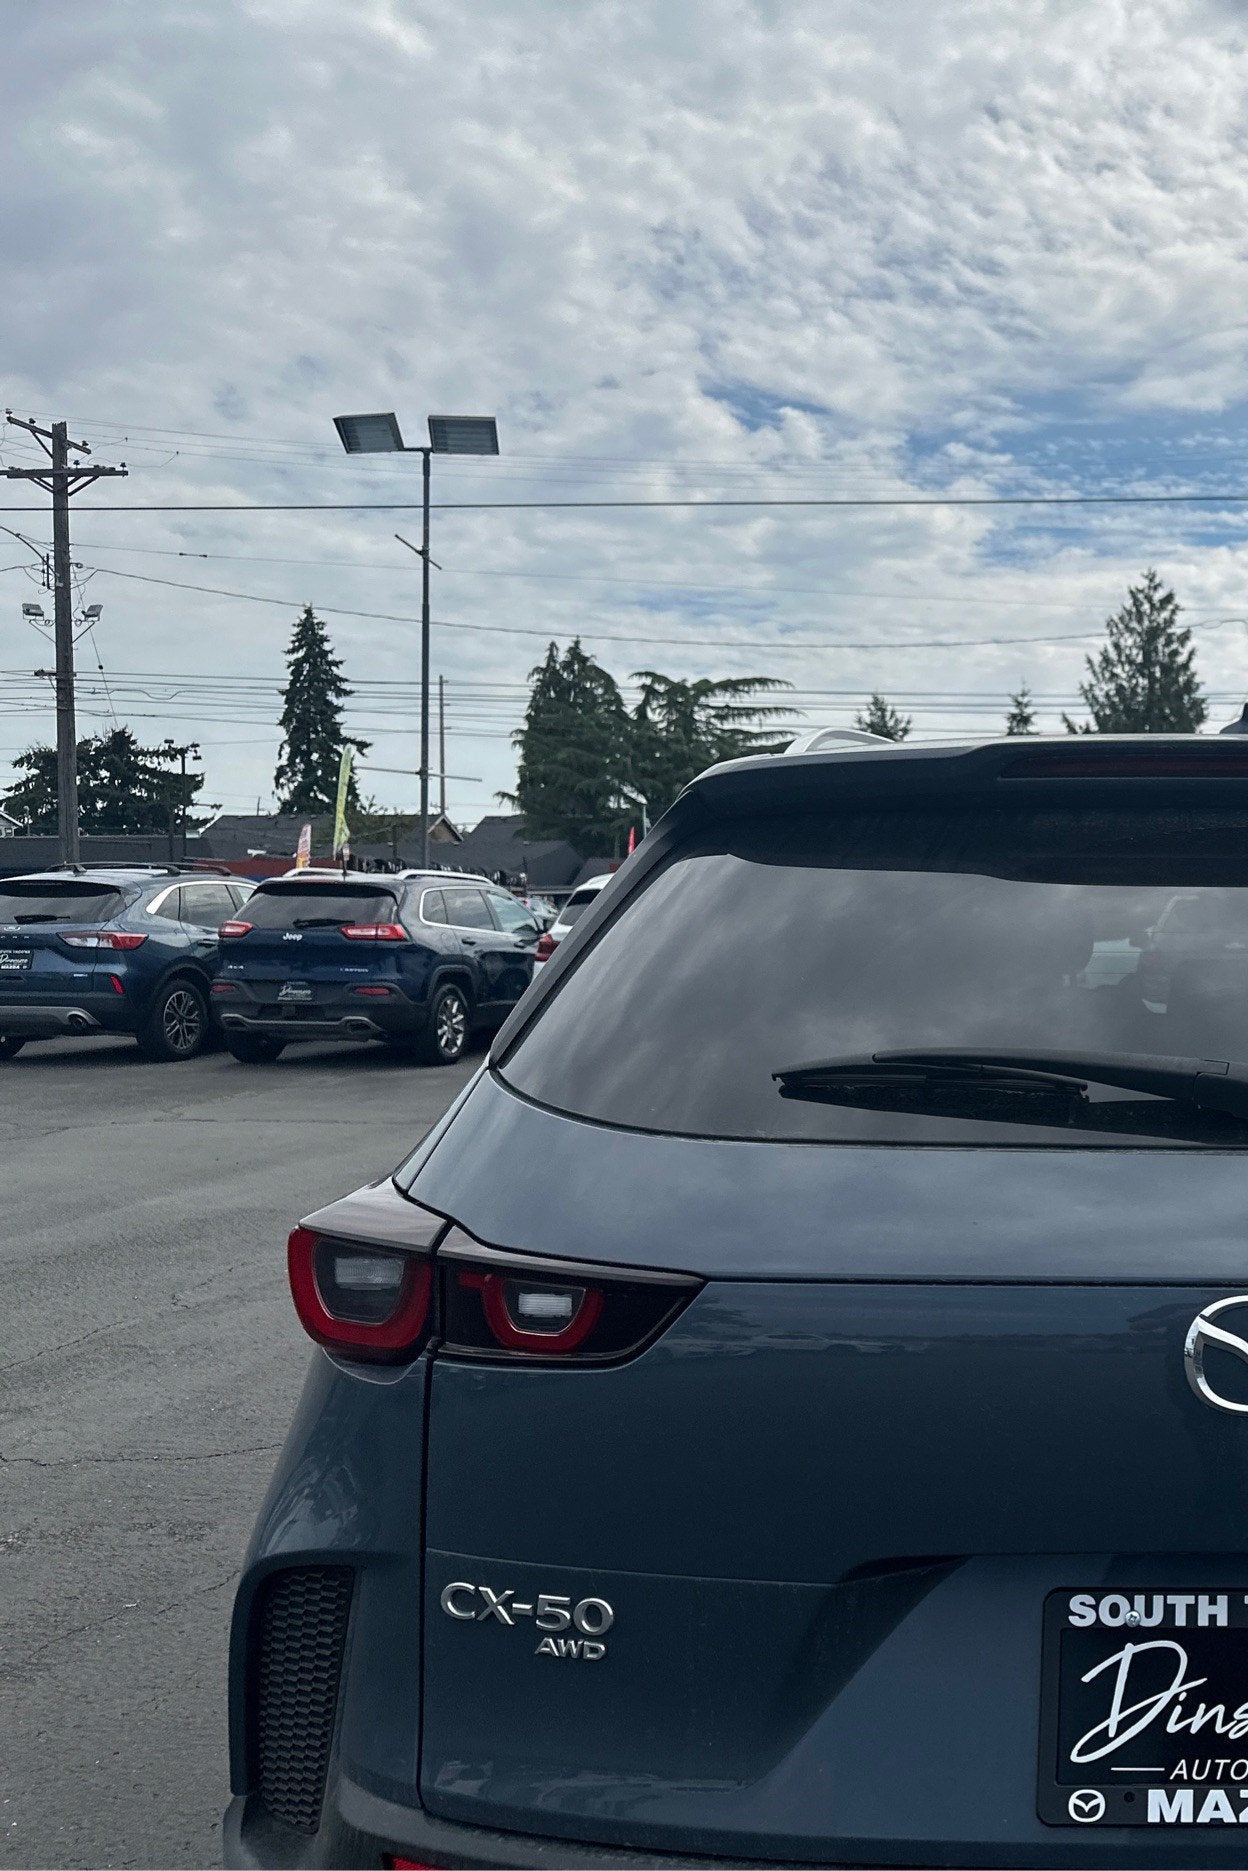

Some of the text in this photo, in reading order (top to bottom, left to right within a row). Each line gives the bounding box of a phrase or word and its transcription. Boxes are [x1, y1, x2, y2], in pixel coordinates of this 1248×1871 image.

[282, 932, 303, 942] Jeep
[440, 1582, 614, 1636] CX-50
[1068, 1595, 1229, 1627] SOUTH
[534, 1637, 606, 1661] AWD
